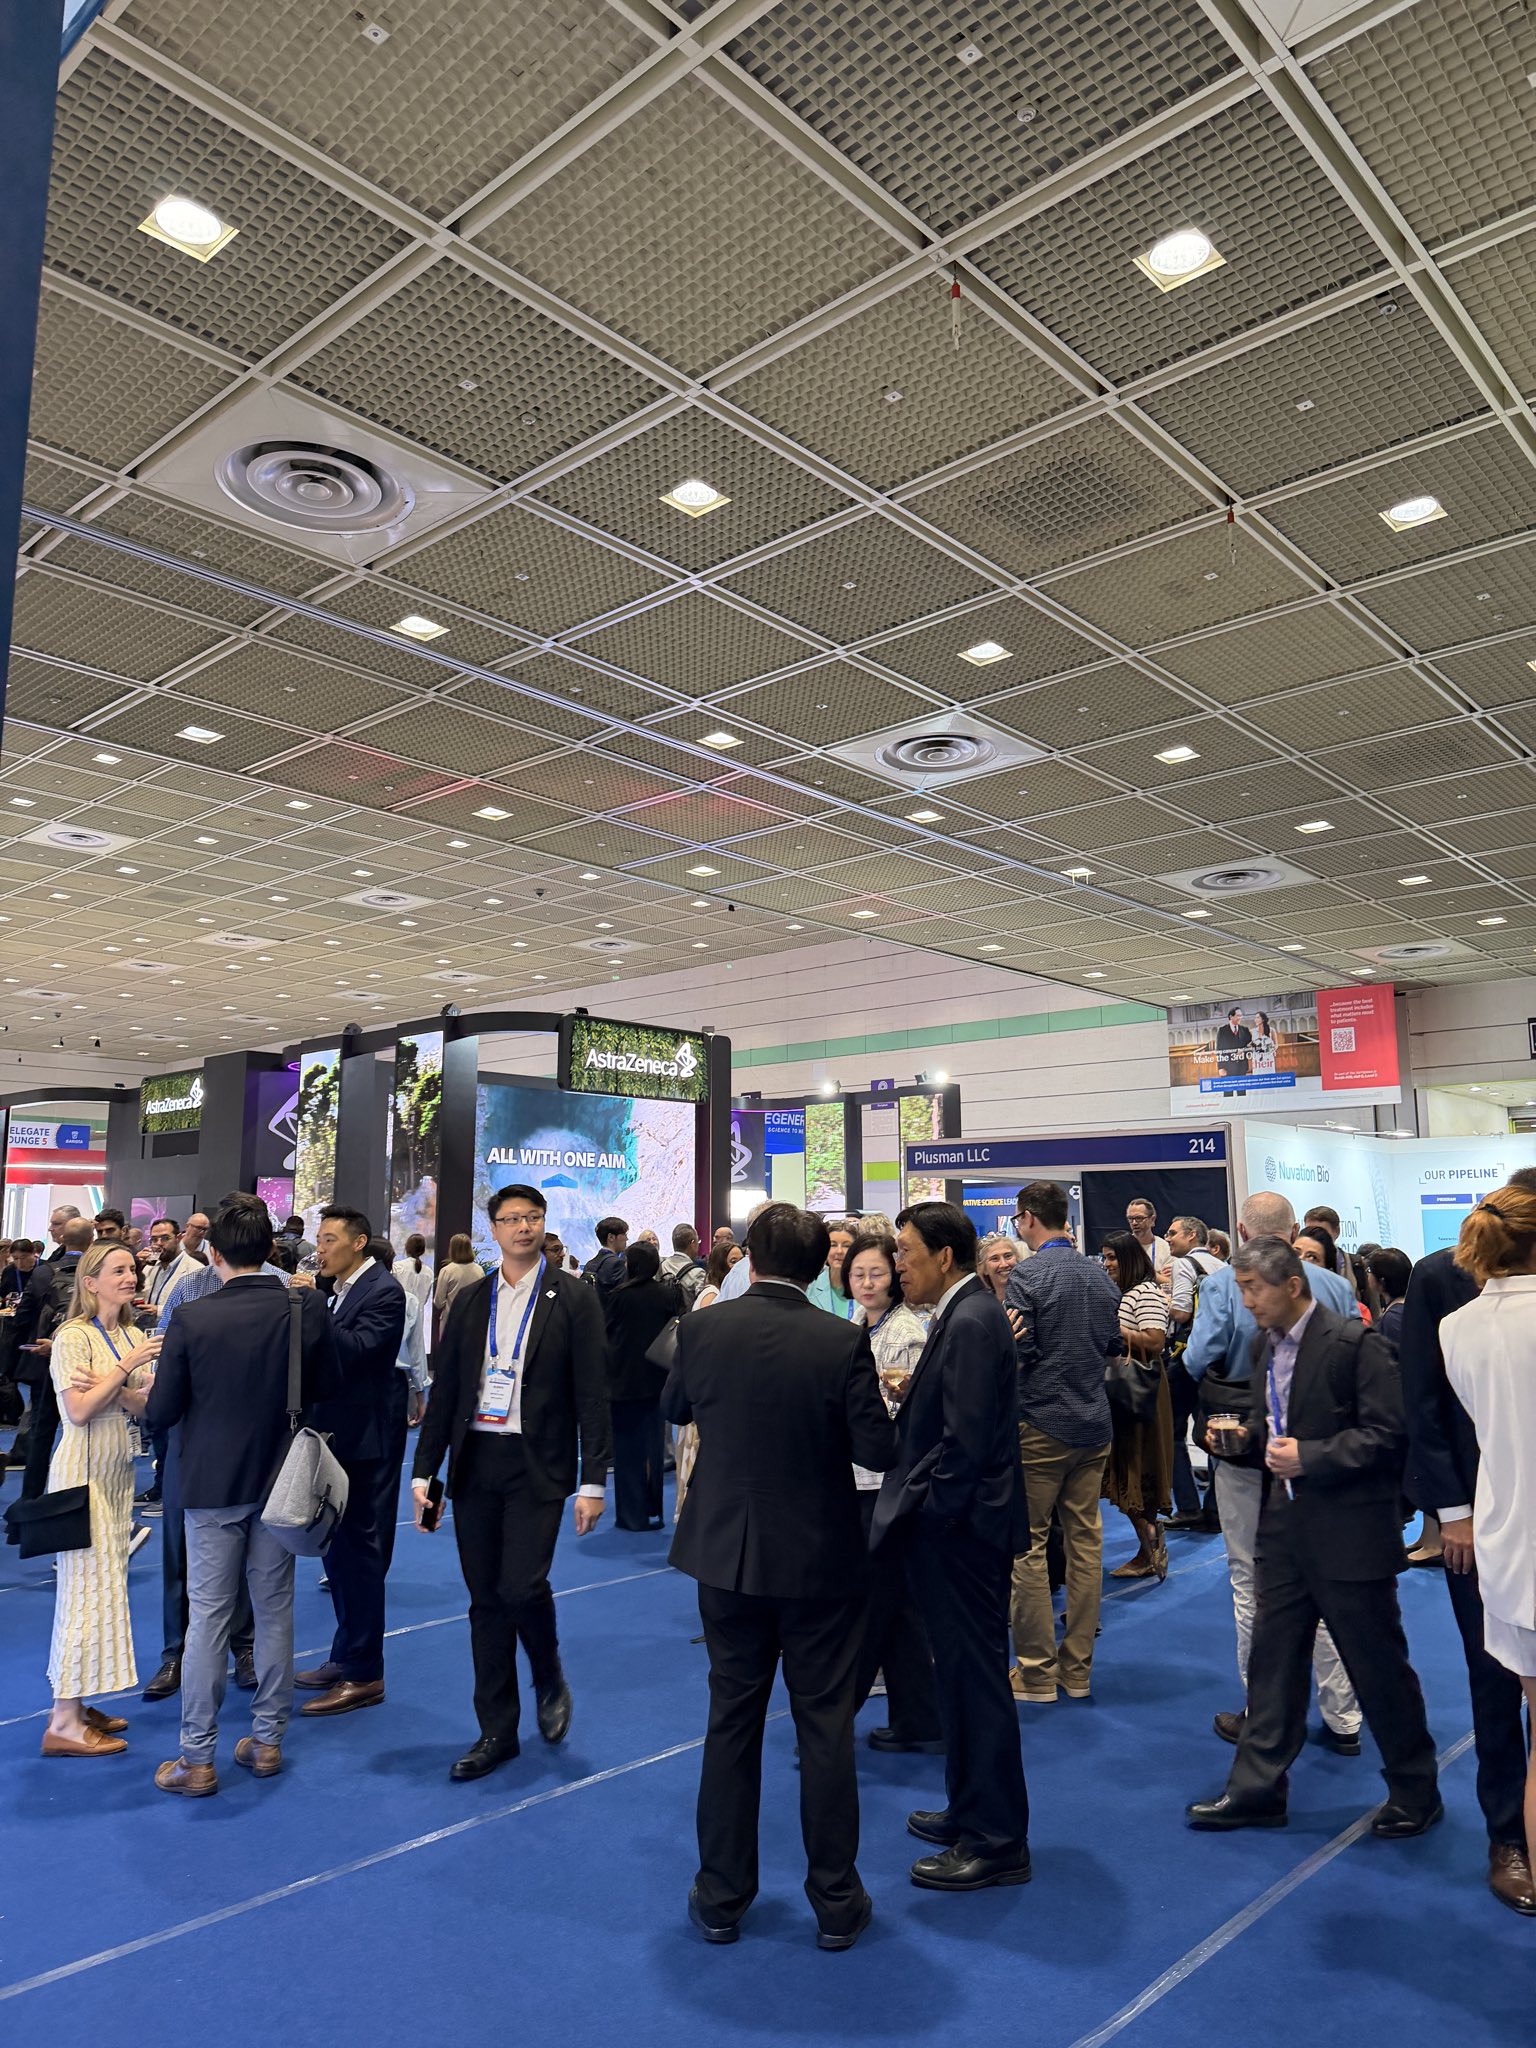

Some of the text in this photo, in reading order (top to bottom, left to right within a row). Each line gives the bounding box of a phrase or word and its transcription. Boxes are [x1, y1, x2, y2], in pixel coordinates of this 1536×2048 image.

[584, 1048, 678, 1076] AstraZeneca
[1193, 1055, 1214, 1064] Make
[1216, 1053, 1230, 1062] the
[1230, 1052, 1245, 1061] 3rd
[145, 1097, 193, 1115] AstraZeneca
[1188, 1138, 1216, 1155] 214
[487, 1147, 626, 1169] ALL WITH ONE AIM
[914, 1148, 991, 1165] Plusman LLC
[1279, 1161, 1330, 1183] Nuvation Bio
[1424, 1168, 1499, 1180] OUR PIPELINE
[982, 1198, 1004, 1206] SCIENCE
